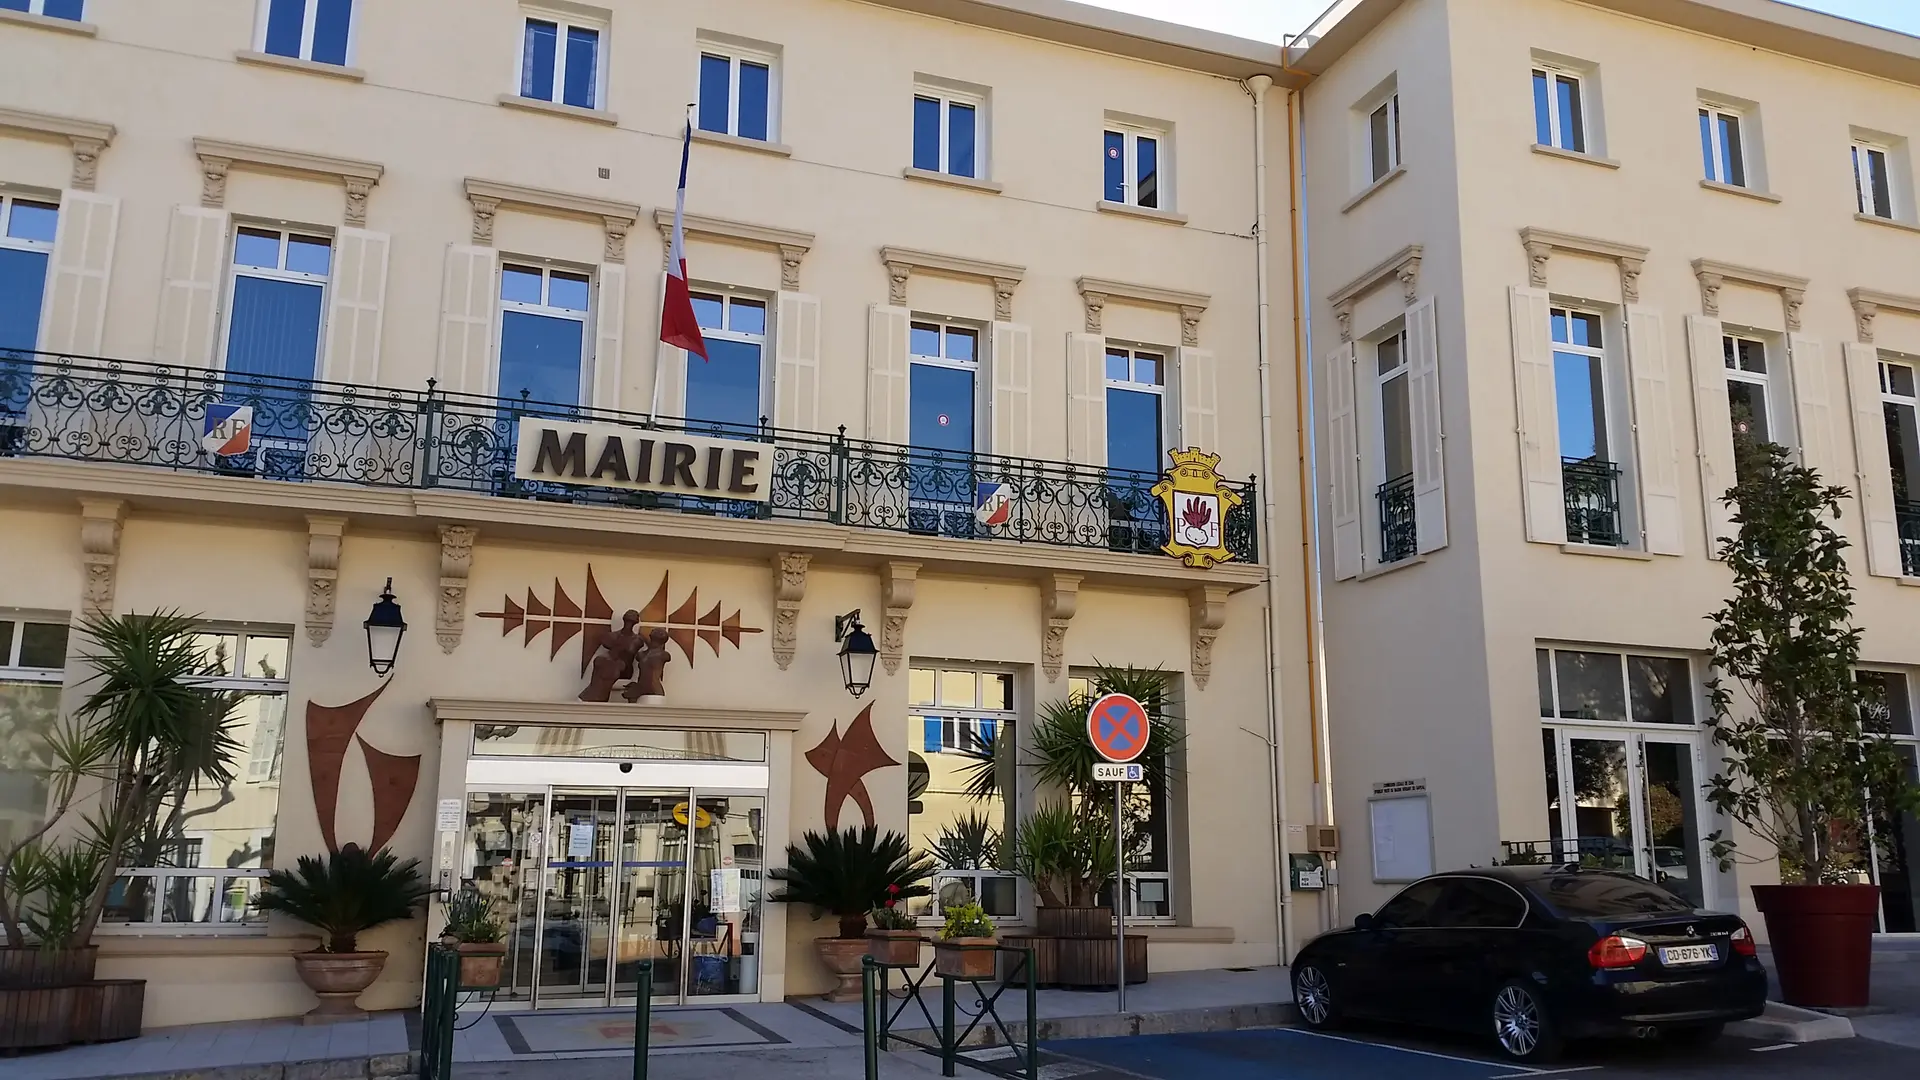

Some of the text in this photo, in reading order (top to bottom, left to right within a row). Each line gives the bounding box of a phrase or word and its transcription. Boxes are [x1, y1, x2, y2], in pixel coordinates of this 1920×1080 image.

[211, 416, 246, 440] RF
[532, 429, 760, 493] MAIRIE
[982, 494, 1006, 512] RF
[1097, 767, 1125, 777] SAUF
[1667, 947, 1713, 961] CD-676-YK
